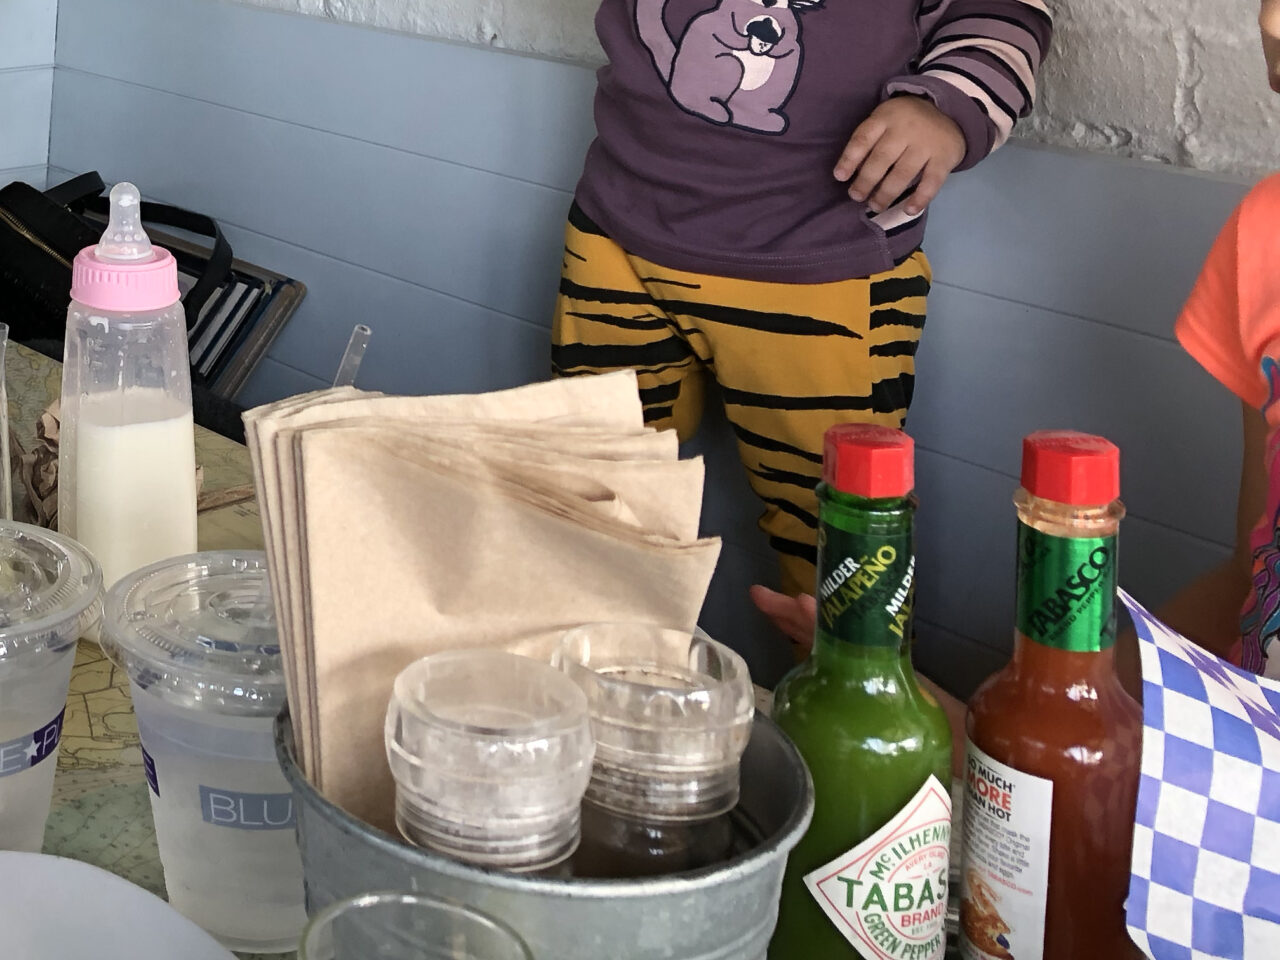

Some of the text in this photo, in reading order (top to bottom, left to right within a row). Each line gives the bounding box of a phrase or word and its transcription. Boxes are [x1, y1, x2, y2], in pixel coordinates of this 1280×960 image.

[820, 556, 861, 600] MILDER
[1027, 546, 1109, 638] TABASCO
[967, 770, 1012, 811] MORE
[977, 766, 1013, 793] MUCH
[209, 792, 295, 826] BLU
[987, 803, 1012, 822] HOT
[836, 868, 948, 913] TABAS
[863, 912, 903, 955] GREEN
[900, 902, 945, 928] BRAND
